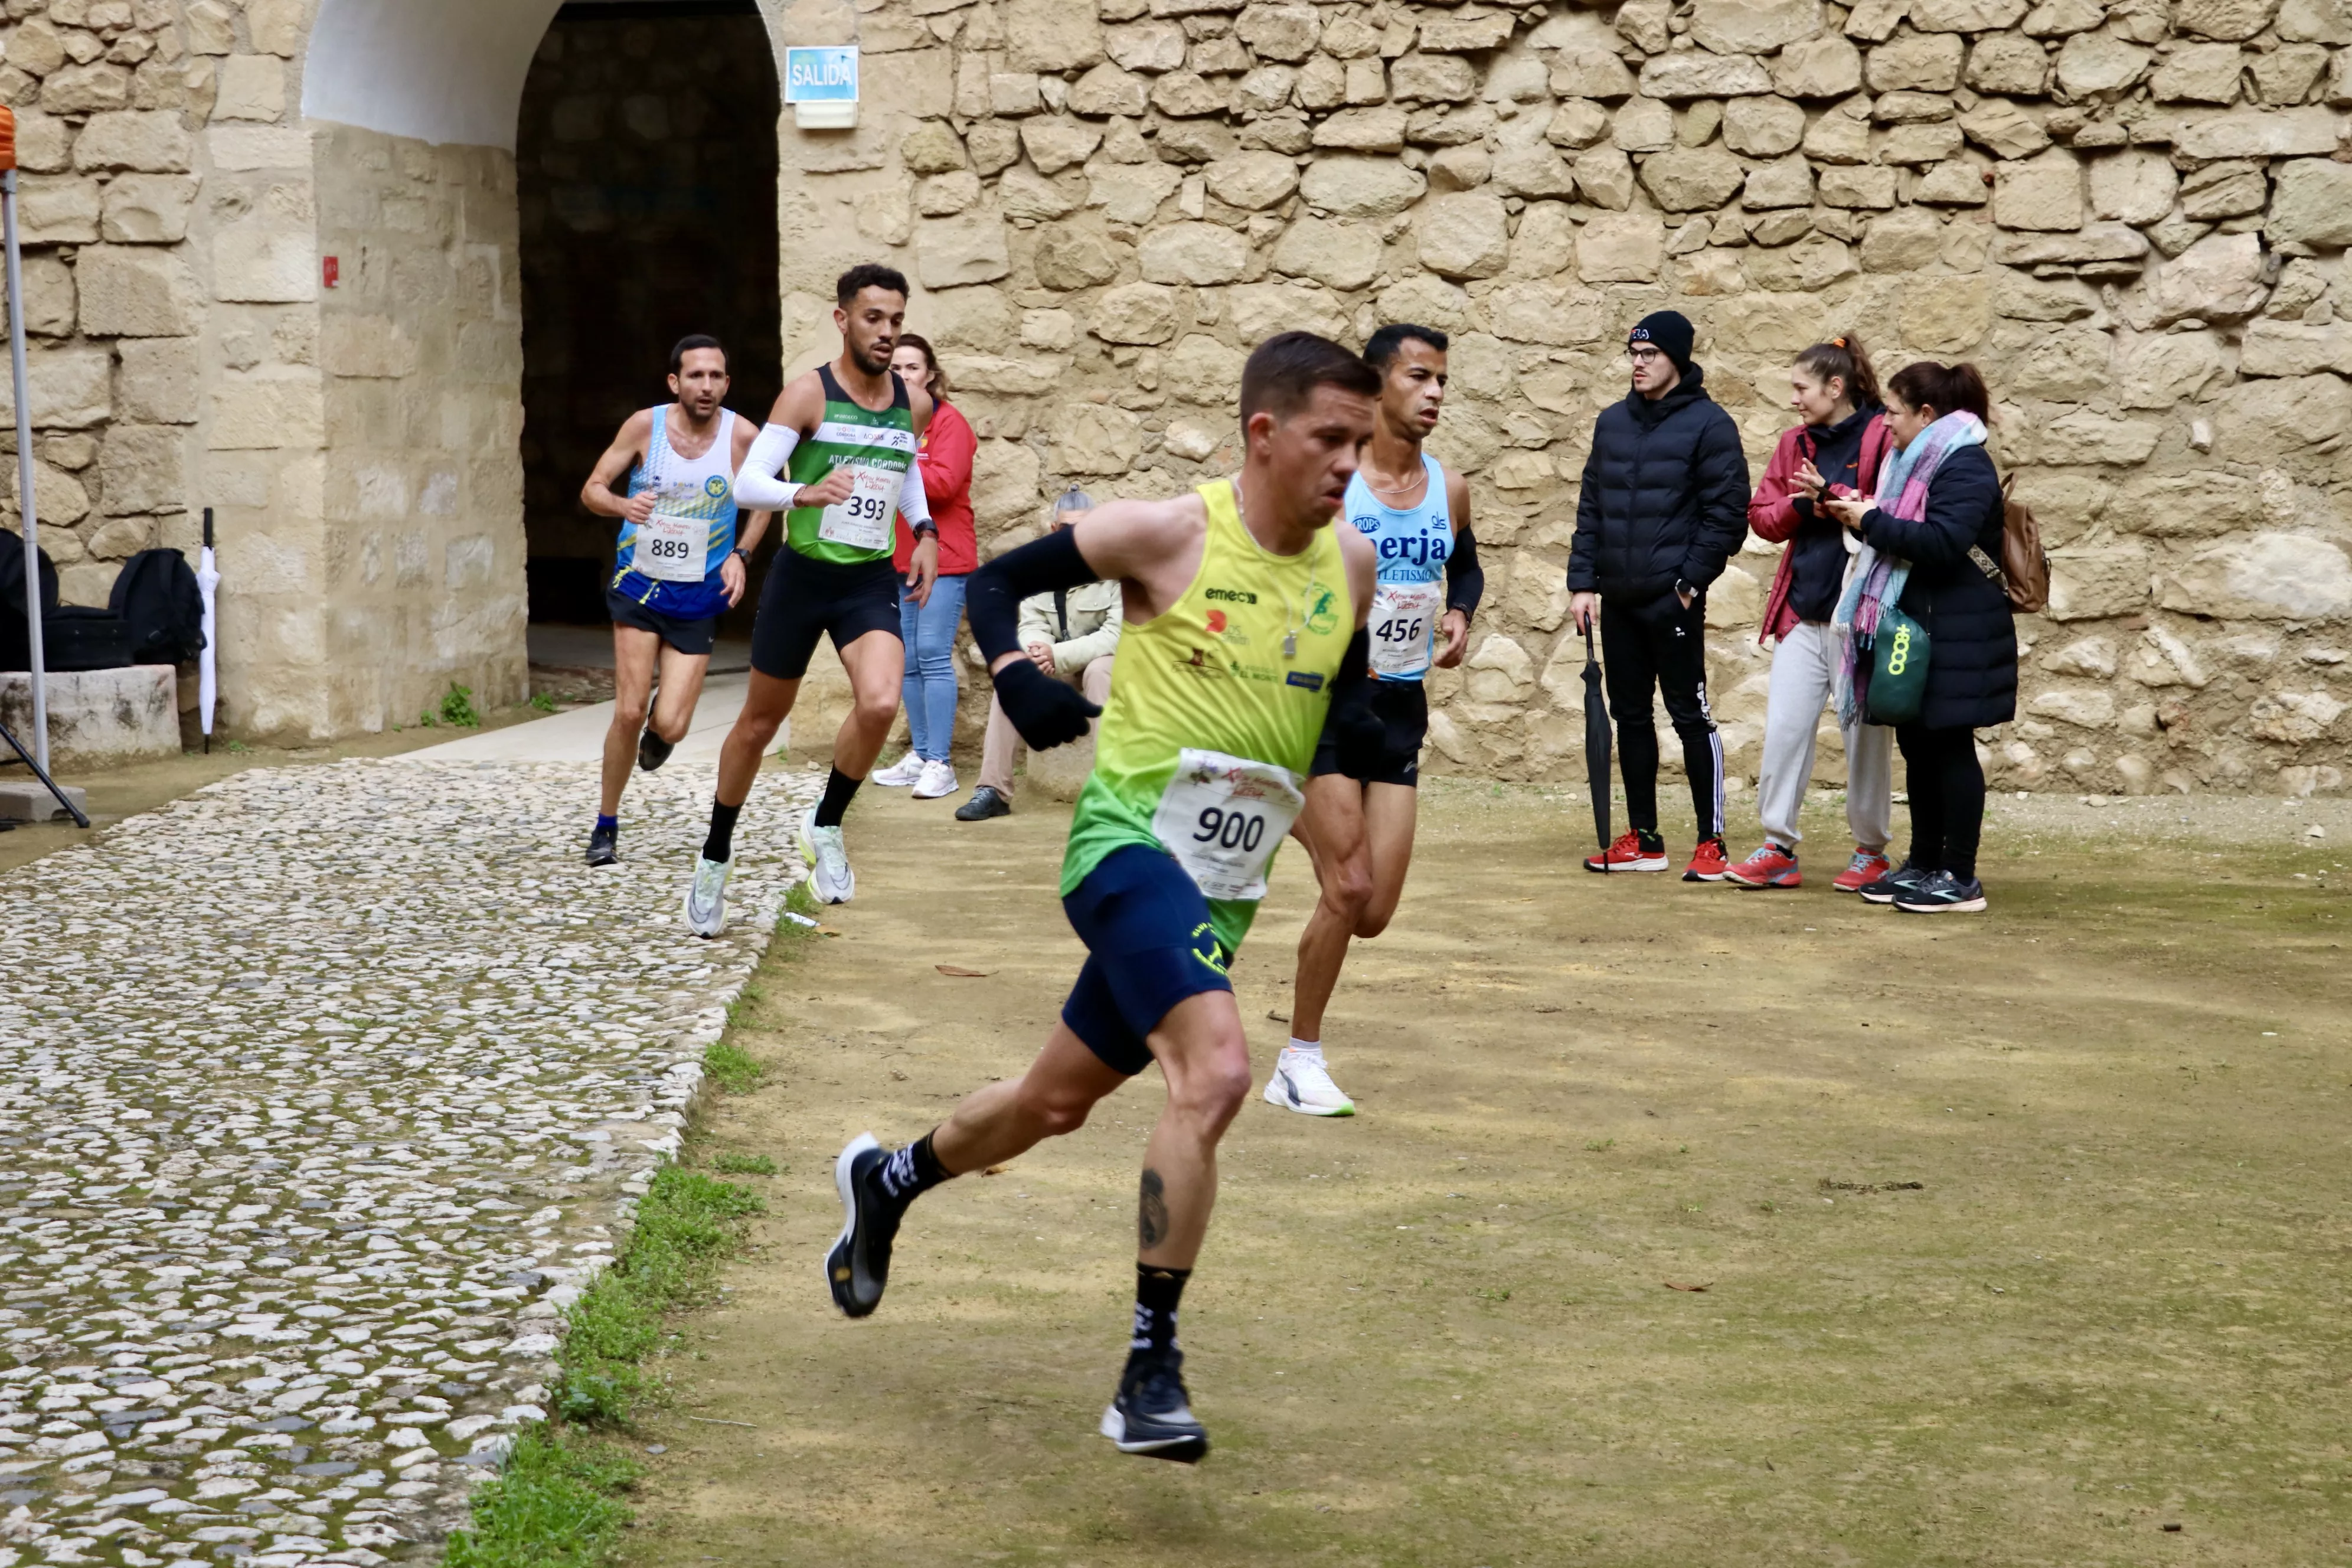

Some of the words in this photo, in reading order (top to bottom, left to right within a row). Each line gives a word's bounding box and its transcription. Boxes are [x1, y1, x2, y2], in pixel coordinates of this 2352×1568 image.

[792, 64, 852, 86] SALIDA
[848, 496, 886, 521] 393
[652, 538, 690, 558] 889
[1376, 570, 1432, 580] TLETISMO
[1376, 618, 1422, 642] 456
[1193, 807, 1265, 852] 900
